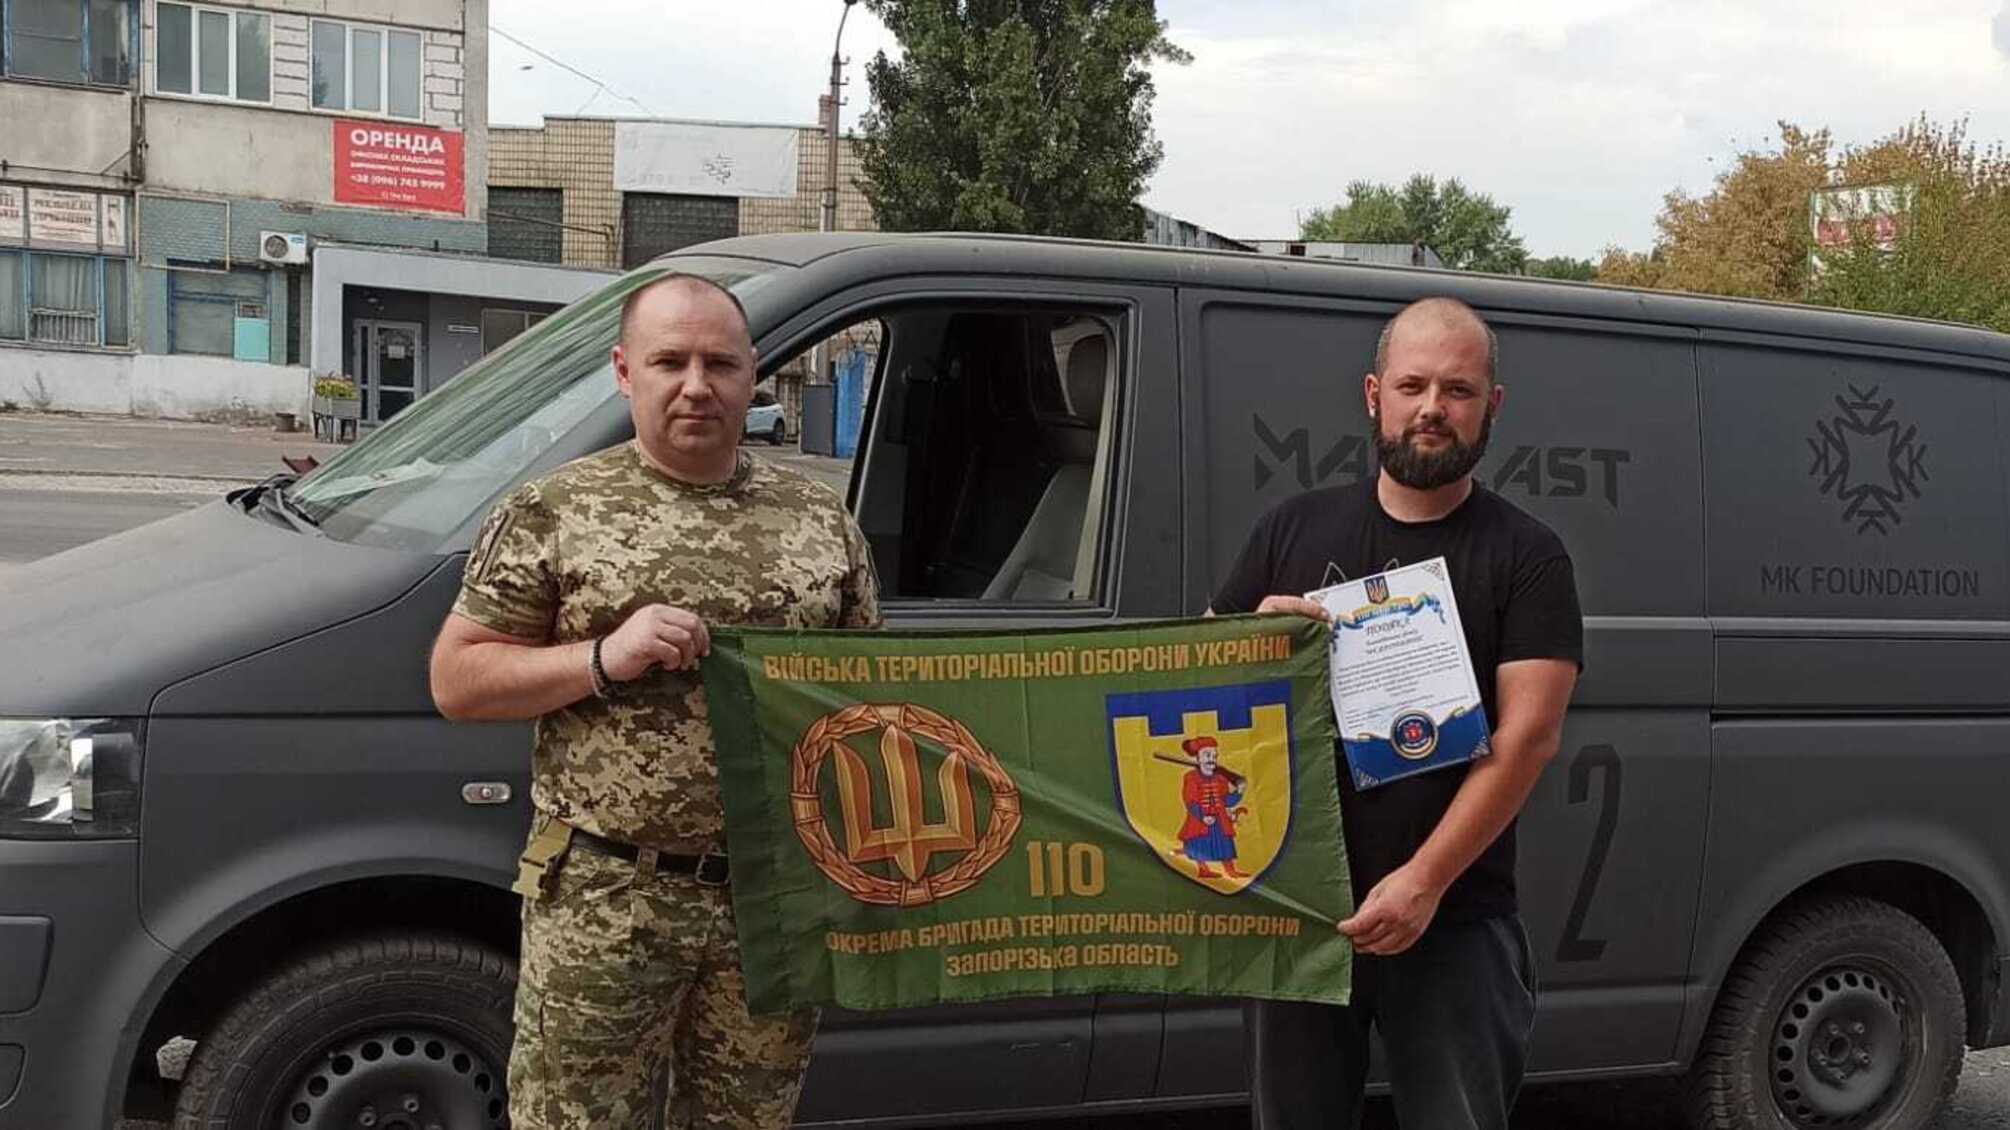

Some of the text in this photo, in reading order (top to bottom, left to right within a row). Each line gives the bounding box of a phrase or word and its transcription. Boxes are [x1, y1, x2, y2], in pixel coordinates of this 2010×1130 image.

[350, 129, 445, 155] ОРЕНДА
[1761, 565, 1979, 597] MK FOUNDATION
[763, 633, 1291, 682] ВІЙСЬКА ТЕРИТОРІАЛЬНОЇ ОБОРОНИ УКРАЇНИ
[1026, 840, 1105, 898] 110
[1557, 744, 1622, 963] 2
[825, 909, 1300, 954] ОКРЕМА БРИГАДА ТЕРИТОРІАЛЬНОЇ ОБОРОНИ
